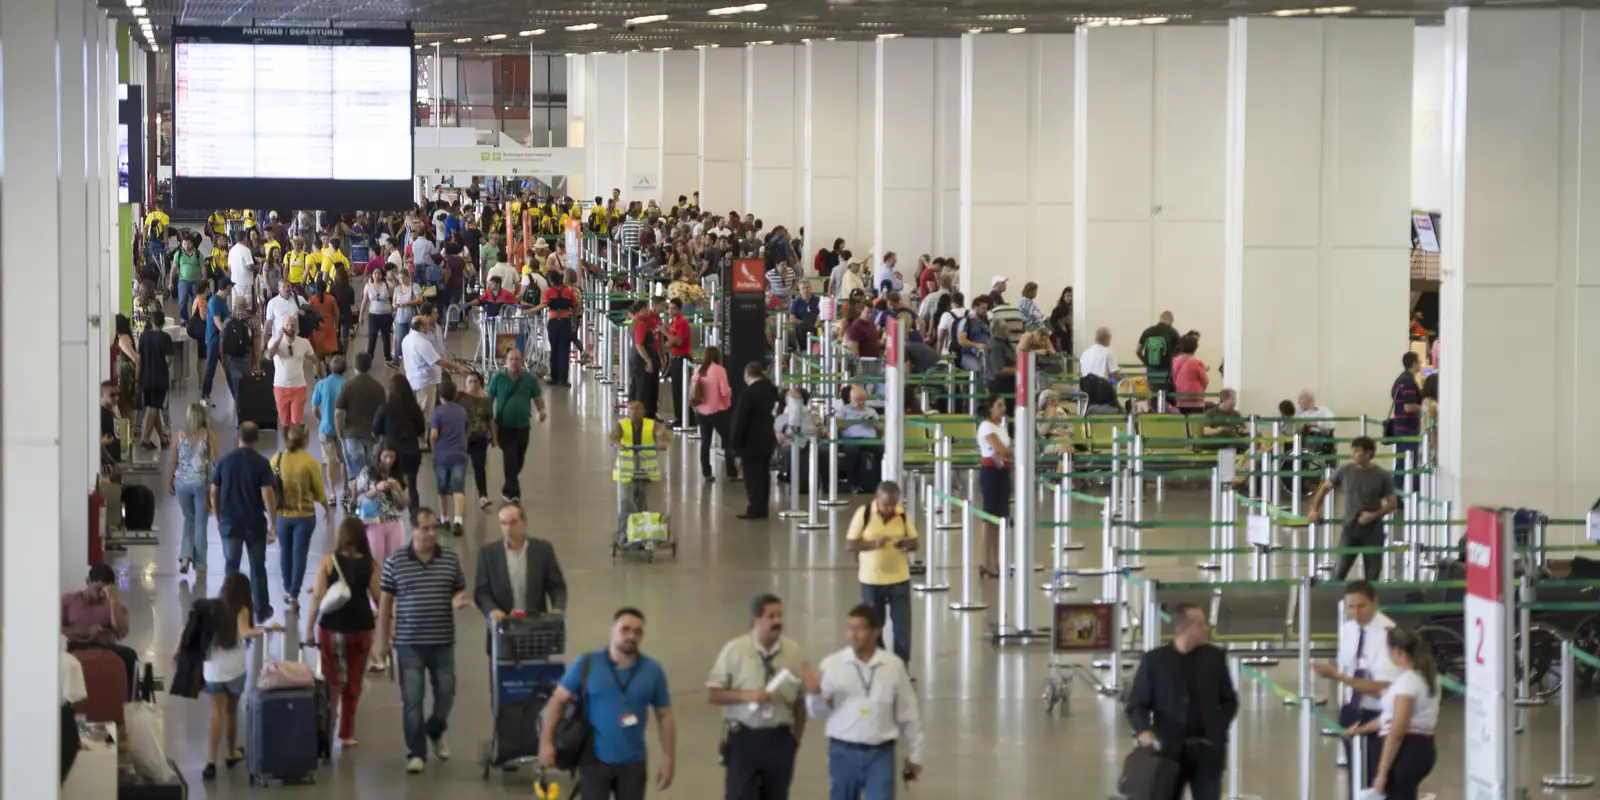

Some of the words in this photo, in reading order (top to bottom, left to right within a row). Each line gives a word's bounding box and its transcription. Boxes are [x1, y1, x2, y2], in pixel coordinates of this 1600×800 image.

[242, 27, 283, 35] PARTIDAS
[289, 28, 344, 36] DEPARTURES
[1475, 617, 1485, 664] 2
